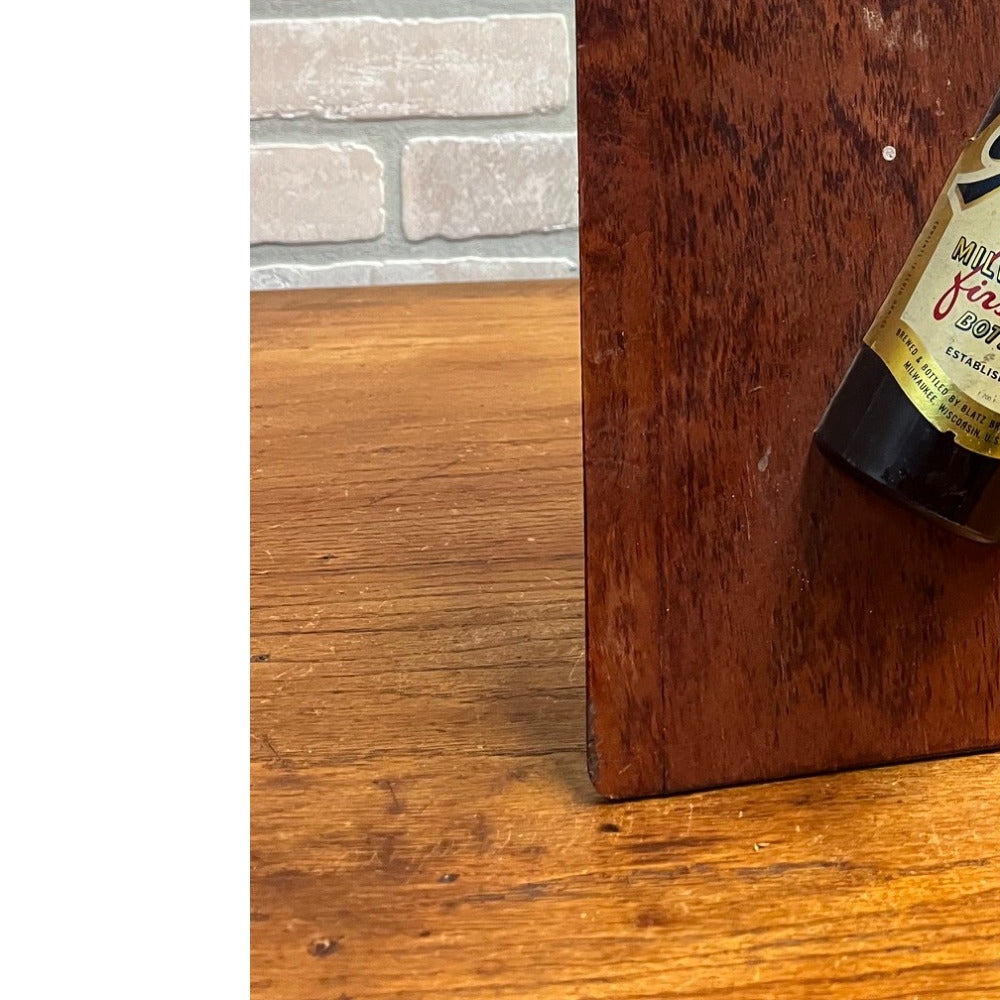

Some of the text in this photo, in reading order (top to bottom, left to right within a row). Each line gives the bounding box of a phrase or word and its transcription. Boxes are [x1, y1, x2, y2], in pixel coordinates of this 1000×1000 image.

[896, 328, 918, 356] BREWED
[921, 364, 949, 396] BOTTLED
[948, 394, 960, 407] BY
[961, 404, 987, 424] BLATZ
